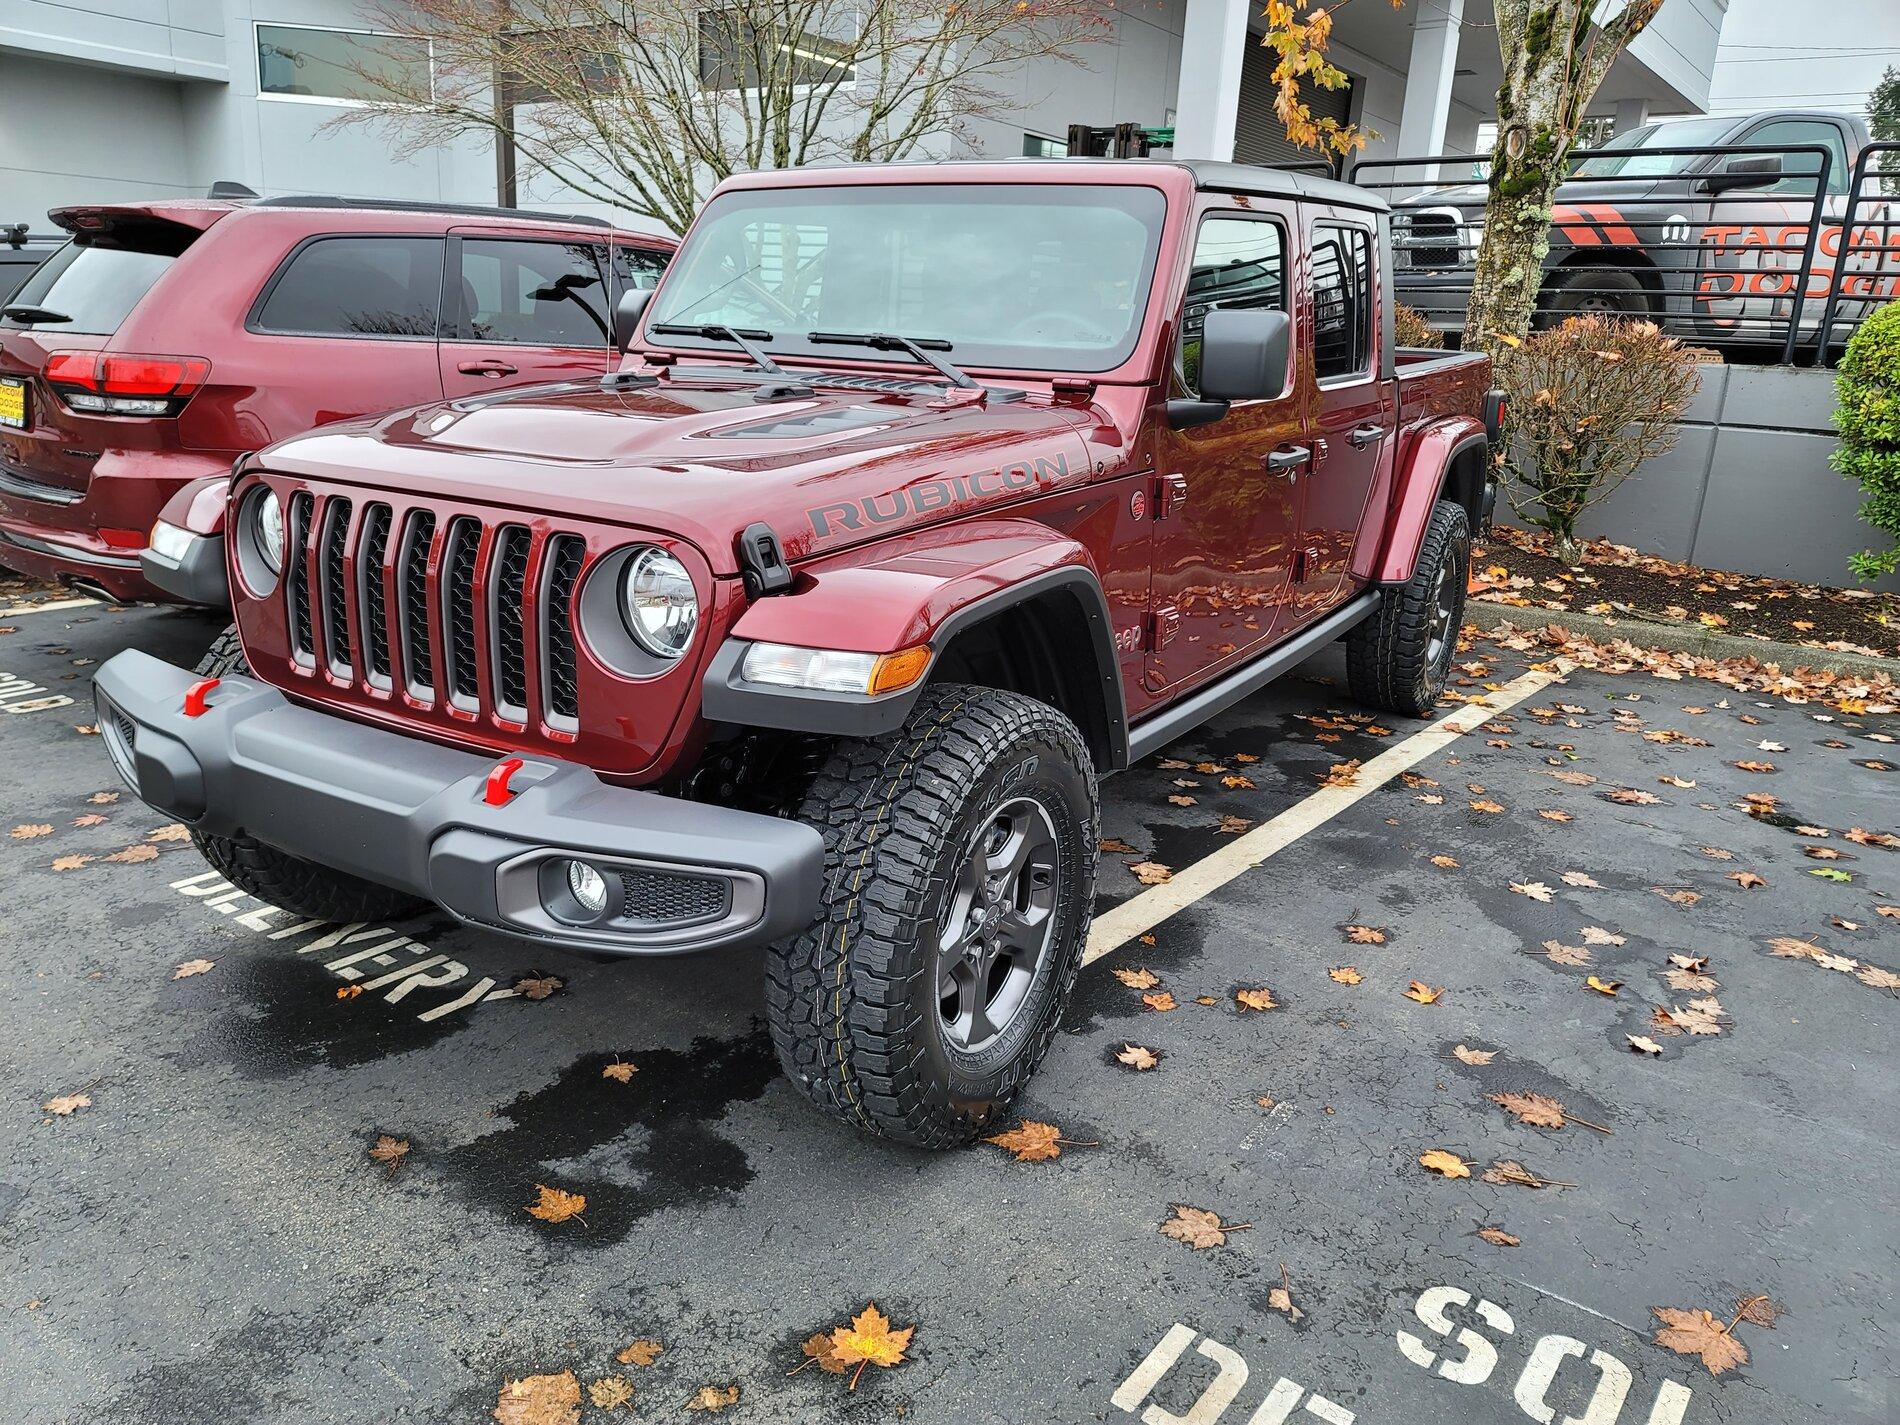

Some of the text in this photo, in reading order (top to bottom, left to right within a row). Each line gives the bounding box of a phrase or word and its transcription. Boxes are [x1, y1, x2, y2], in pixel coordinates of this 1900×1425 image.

[1697, 266, 1900, 301] DODG
[806, 451, 1071, 538] RUBICON
[1114, 625, 1141, 652] eep
